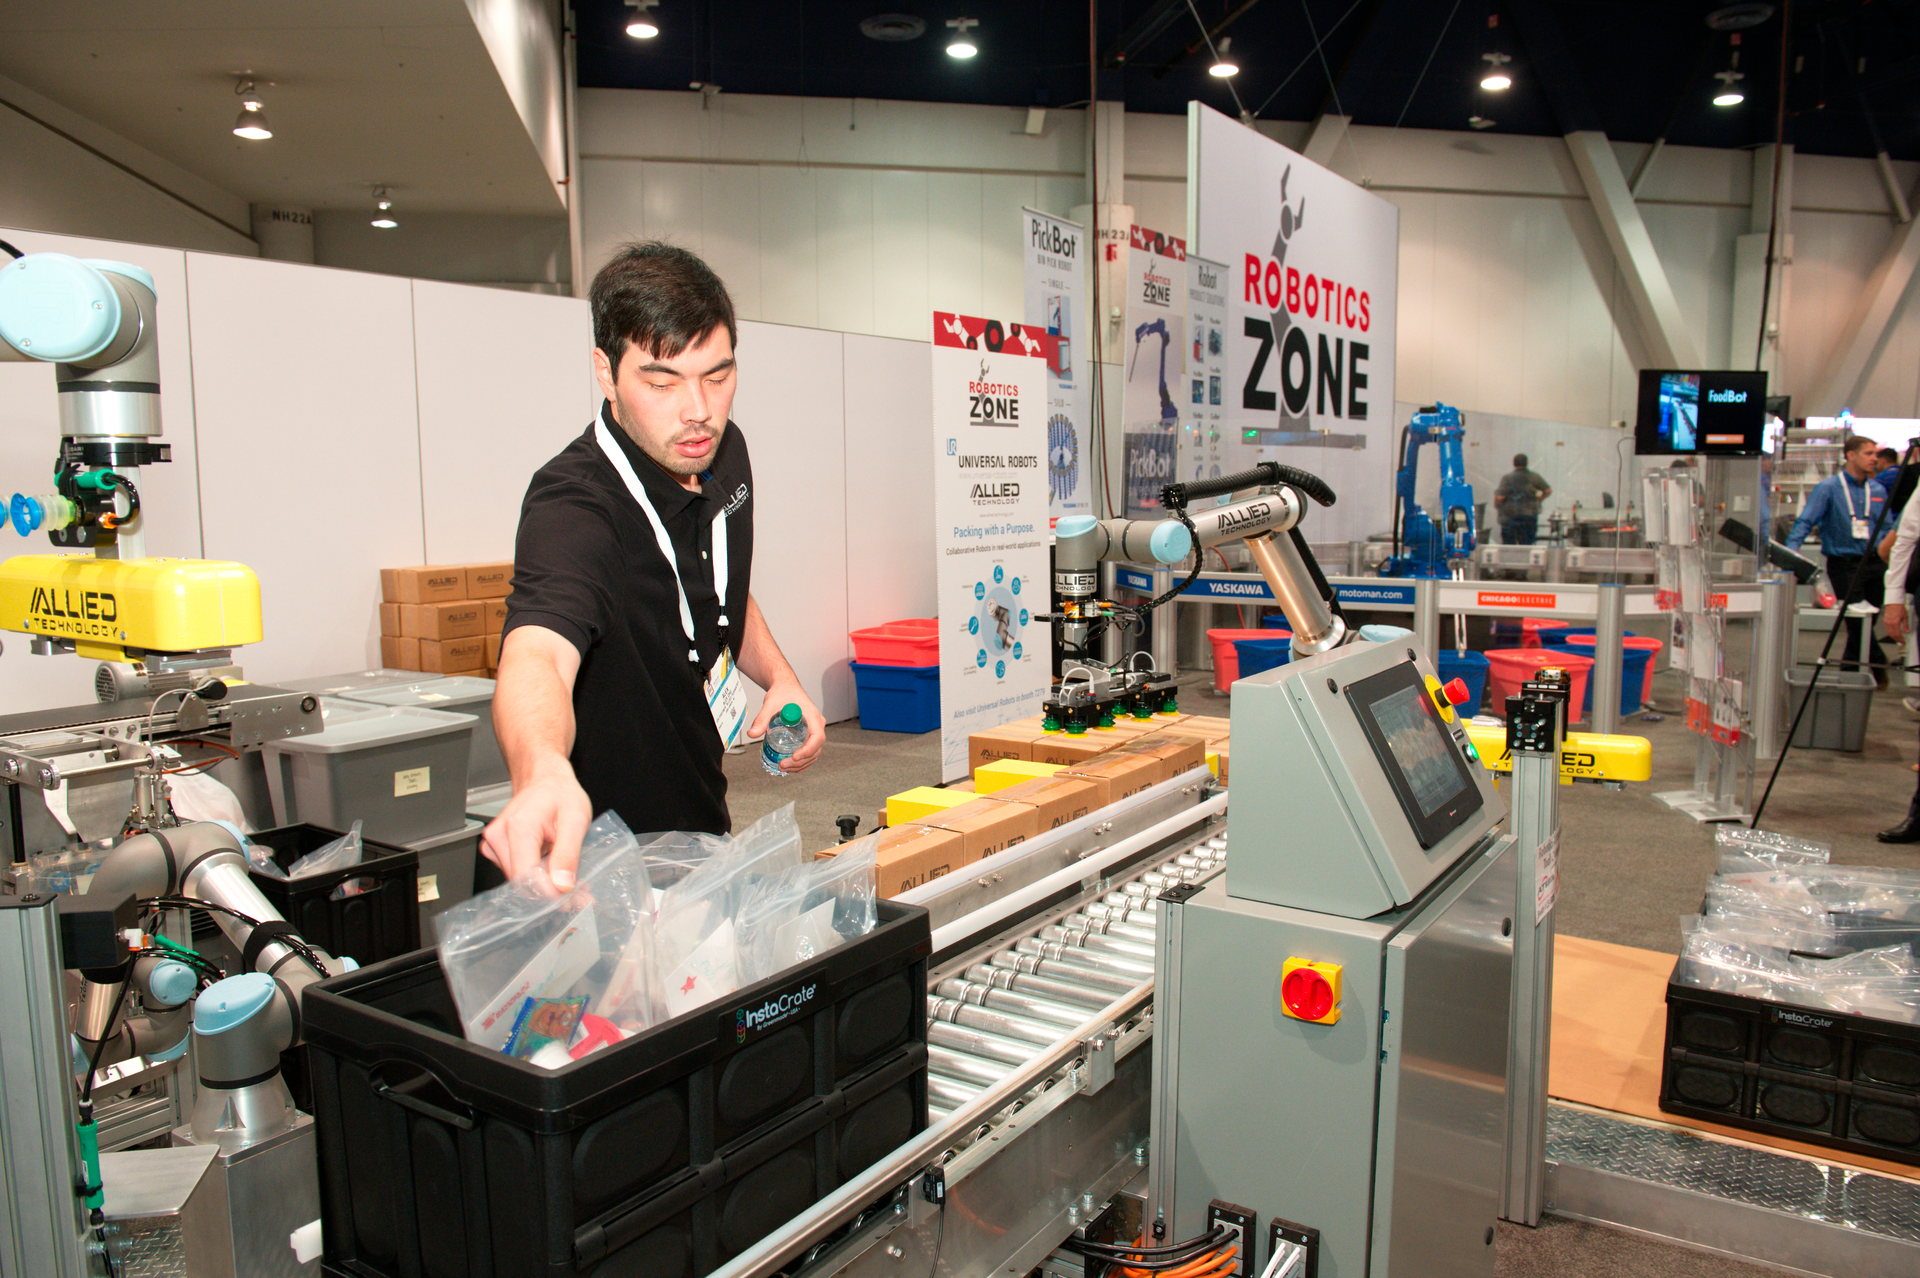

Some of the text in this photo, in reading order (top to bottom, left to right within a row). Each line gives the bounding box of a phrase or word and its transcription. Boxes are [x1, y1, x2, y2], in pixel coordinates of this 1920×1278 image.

[1144, 272, 1171, 286] ROBOTICS
[1144, 281, 1171, 302] ZONE
[1244, 252, 1370, 333] ROBOTICS
[1243, 316, 1370, 421] ZONE
[969, 381, 1019, 397] ROBOTICS
[1708, 389, 1748, 403] FoodBot
[969, 395, 1019, 420] ZONE
[958, 455, 1038, 468] UNIVERSAL ROBOTS
[970, 482, 1020, 498] ALLIED
[972, 498, 1020, 506] TECHNOLOGY
[1218, 502, 1271, 529] ALLIED
[953, 525, 983, 539] Packing
[984, 523, 999, 536] with
[1000, 526, 1005, 535] a
[1006, 523, 1035, 536] Purpose.
[1221, 516, 1272, 536] TECHNOLOGY
[946, 547, 975, 556] Collaborative
[975, 545, 991, 553] Robots
[1017, 541, 1041, 550] applications
[1056, 575, 1096, 585] LLIED
[1209, 583, 1264, 595] YASKAWA
[1339, 589, 1403, 599] motoman.com
[30, 587, 117, 622] ALLIED
[33, 617, 118, 637] TECHNOLOGY
[953, 709, 965, 719] Also
[965, 706, 976, 716] visit
[976, 699, 998, 713] Universal
[999, 696, 1015, 707] Robots
[1021, 690, 1034, 701] booth
